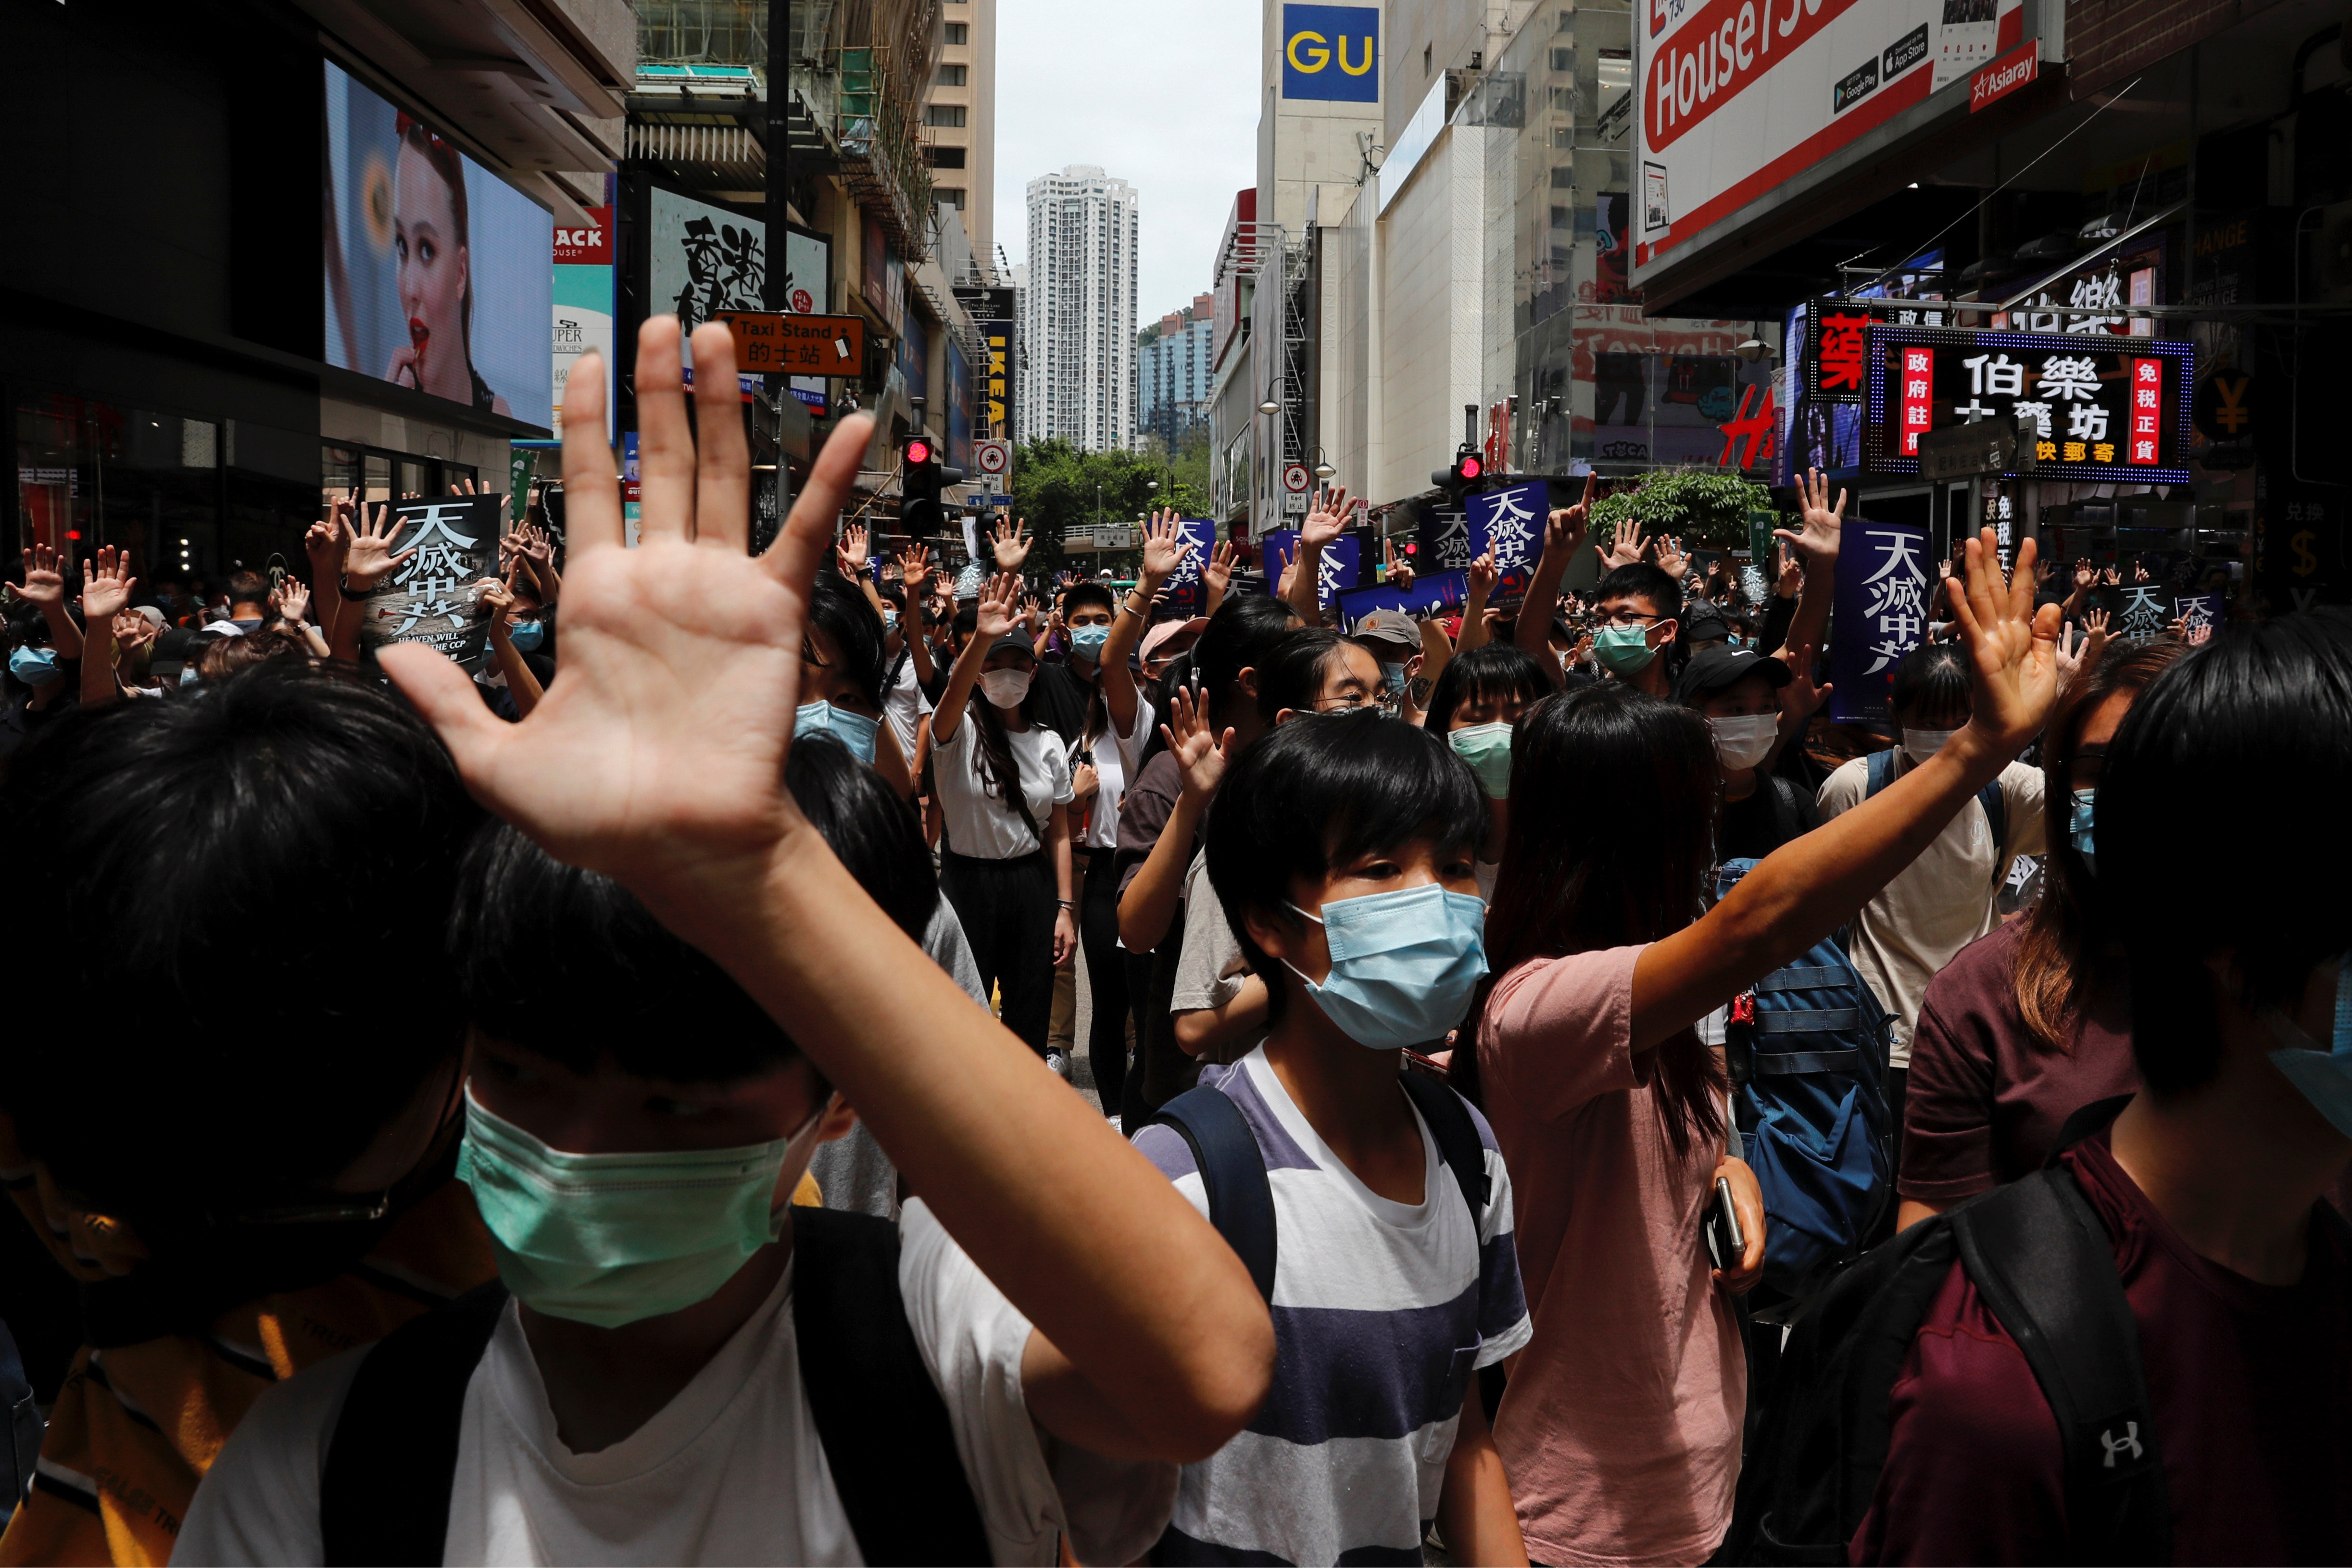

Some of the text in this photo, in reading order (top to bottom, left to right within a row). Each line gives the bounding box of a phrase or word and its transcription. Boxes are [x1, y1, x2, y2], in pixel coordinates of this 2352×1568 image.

[1287, 31, 1373, 75] GU
[1895, 38, 1912, 55] Download
[1895, 42, 1925, 69] App Store
[1846, 74, 1876, 100] Google Play
[1987, 55, 2034, 96] Asiaray
[553, 229, 602, 247] ACK
[2217, 273, 2239, 289] ONG
[1323, 241, 1335, 354] FASHION WALK
[740, 321, 831, 339] Taxi Stand
[748, 341, 820, 365] 的士站
[989, 336, 1006, 423] IKEA
[1962, 353, 2103, 401] 伯樂
[1482, 488, 1536, 576] 天滅中共
[389, 502, 479, 637] 天滅中共
[1861, 530, 1927, 675] 天滅中共
[436, 632, 459, 641] WILL
[449, 640, 466, 649] CCP
